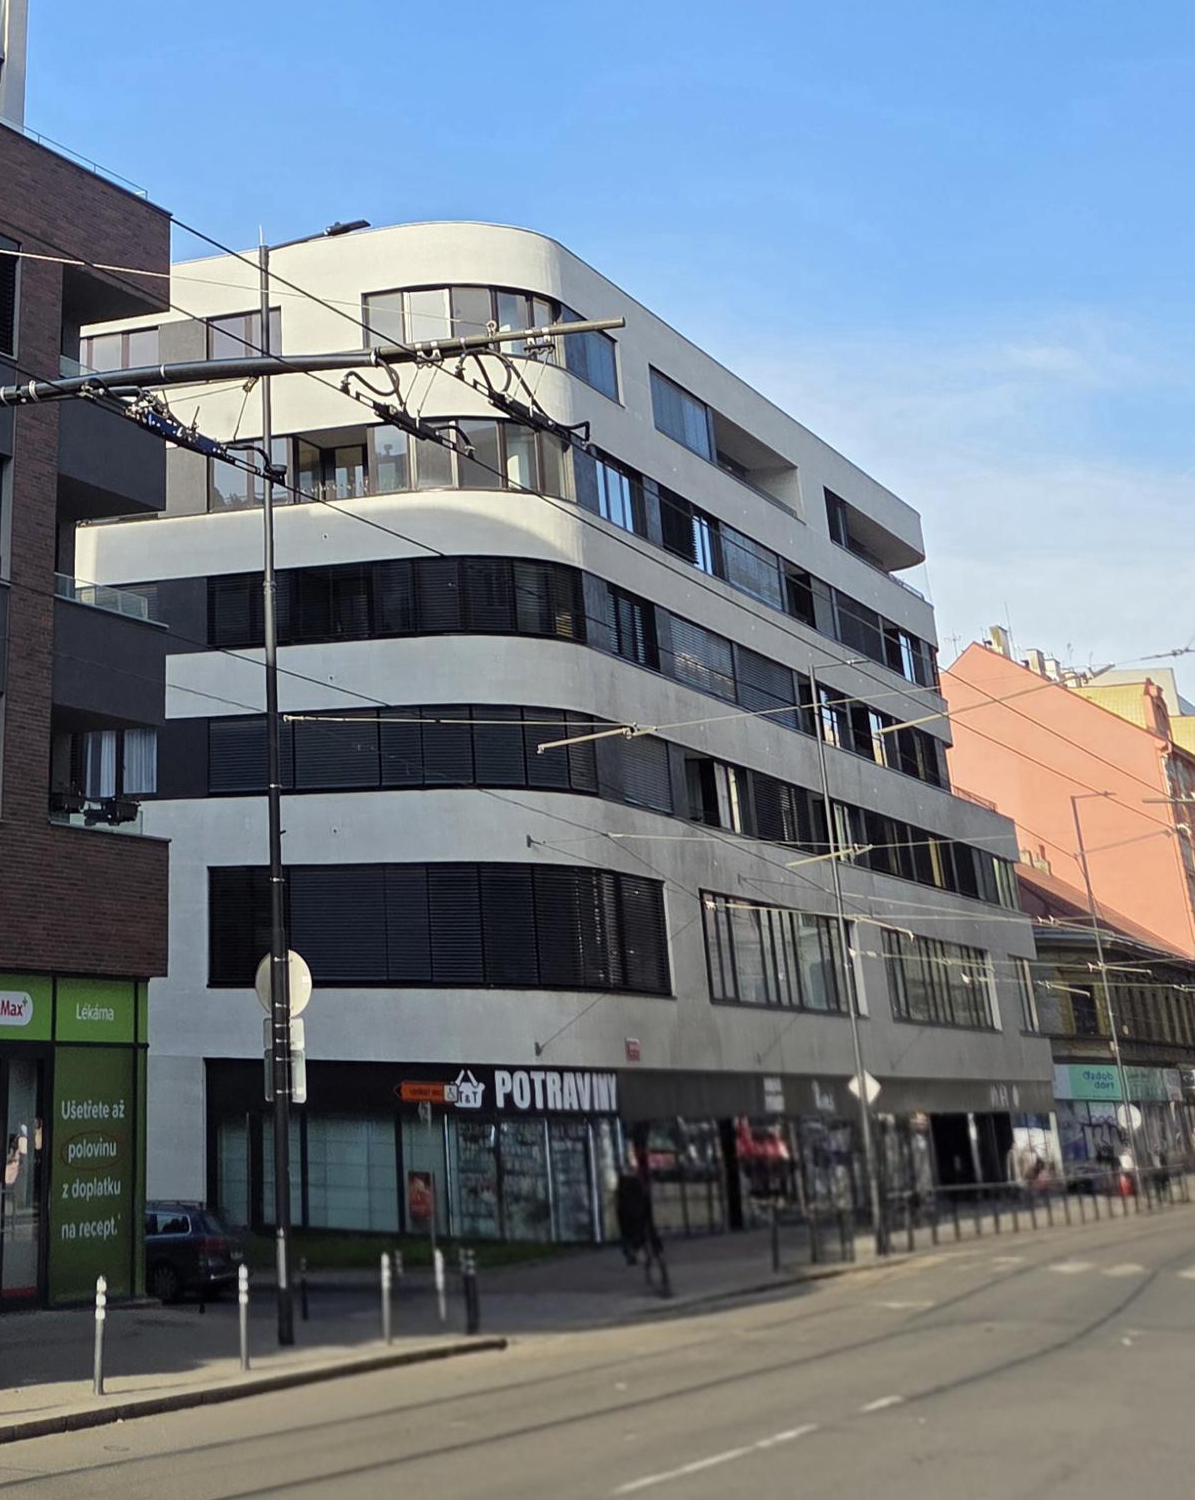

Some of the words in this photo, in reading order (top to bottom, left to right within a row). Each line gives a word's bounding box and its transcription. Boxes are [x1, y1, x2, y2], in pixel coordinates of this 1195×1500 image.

[76, 1003, 114, 1021] Lékárna
[494, 1070, 617, 1110] POTRAVINY
[61, 1100, 110, 1119] Ušetřete
[112, 1100, 124, 1118] až
[68, 1137, 117, 1163] polovinu
[62, 1183, 68, 1198] z
[72, 1176, 121, 1201] doplatku
[61, 1223, 75, 1240] na
